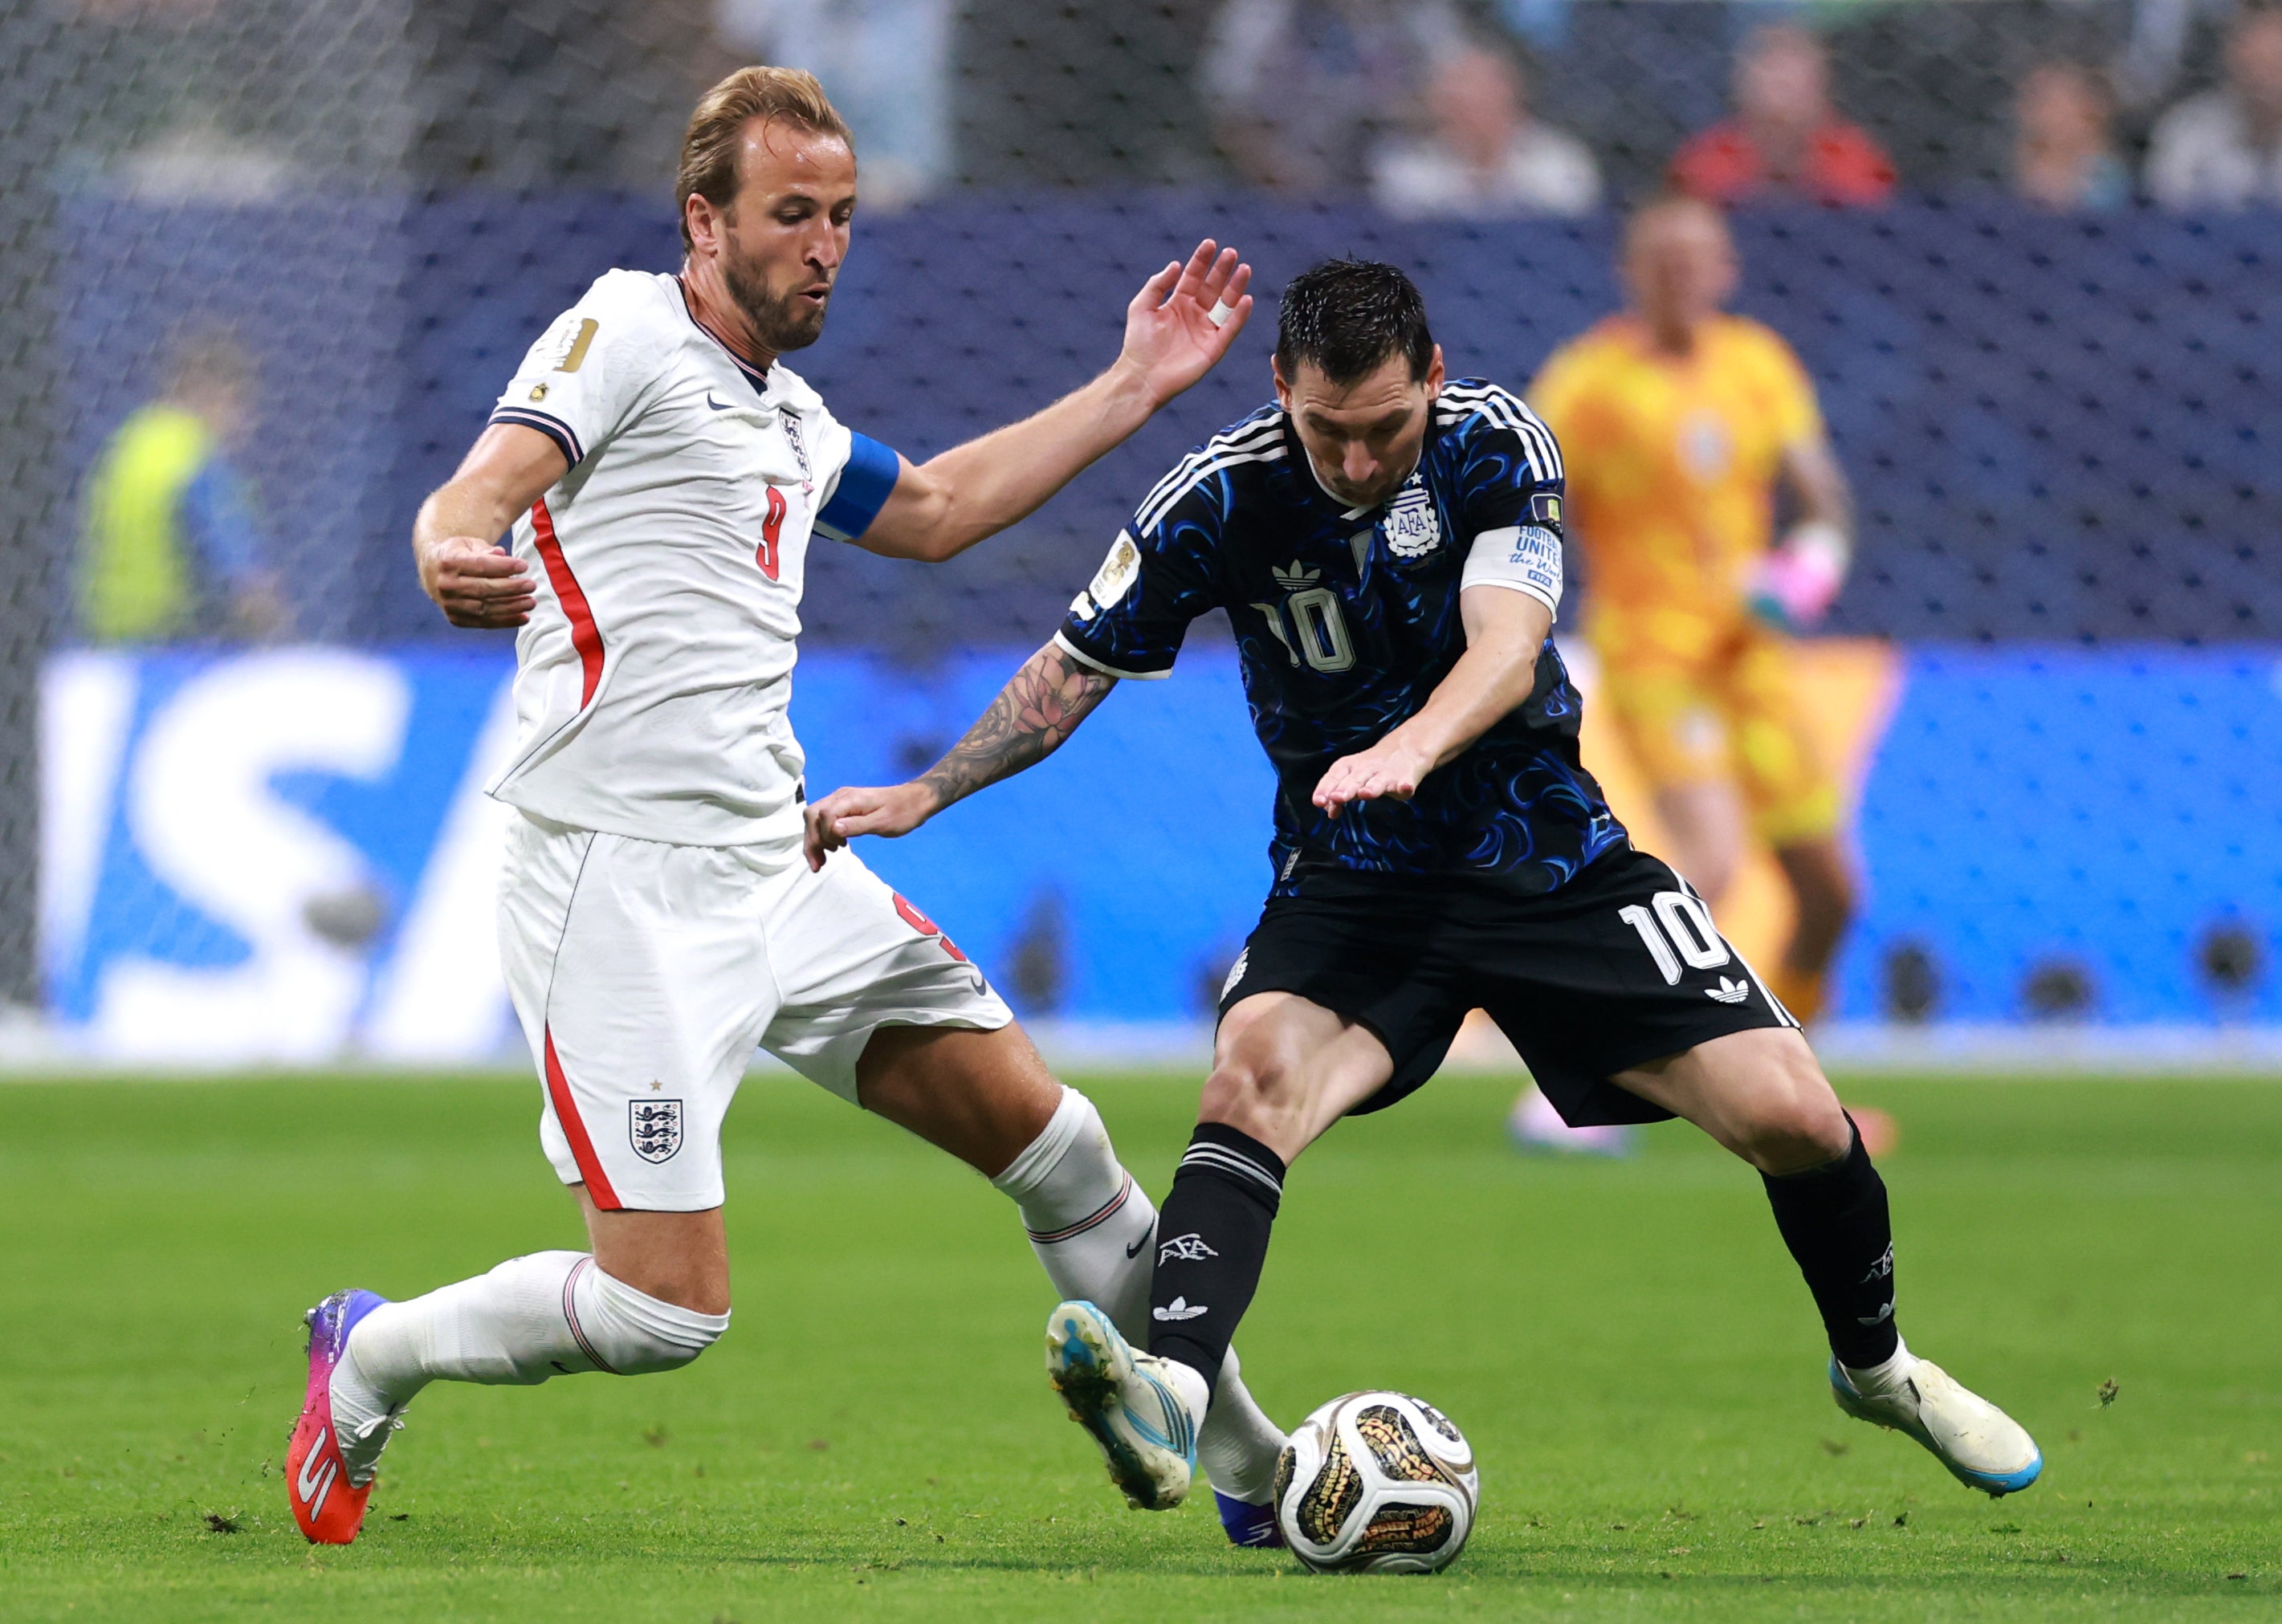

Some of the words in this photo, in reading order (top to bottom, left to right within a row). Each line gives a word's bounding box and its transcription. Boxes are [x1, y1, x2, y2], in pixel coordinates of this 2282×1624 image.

[755, 485, 787, 582] 9
[1398, 507, 1427, 537] AFA
[1508, 552, 1534, 566] the
[1516, 536, 1560, 568] UNITE
[1530, 570, 1551, 587] FIFA
[1247, 587, 1356, 674] 10
[1617, 891, 1730, 986] 10
[1359, 1426, 1428, 1482] MIAMI
[1365, 1418, 1434, 1475] DALLAS
[1324, 1455, 1352, 1537] ATLANTA
